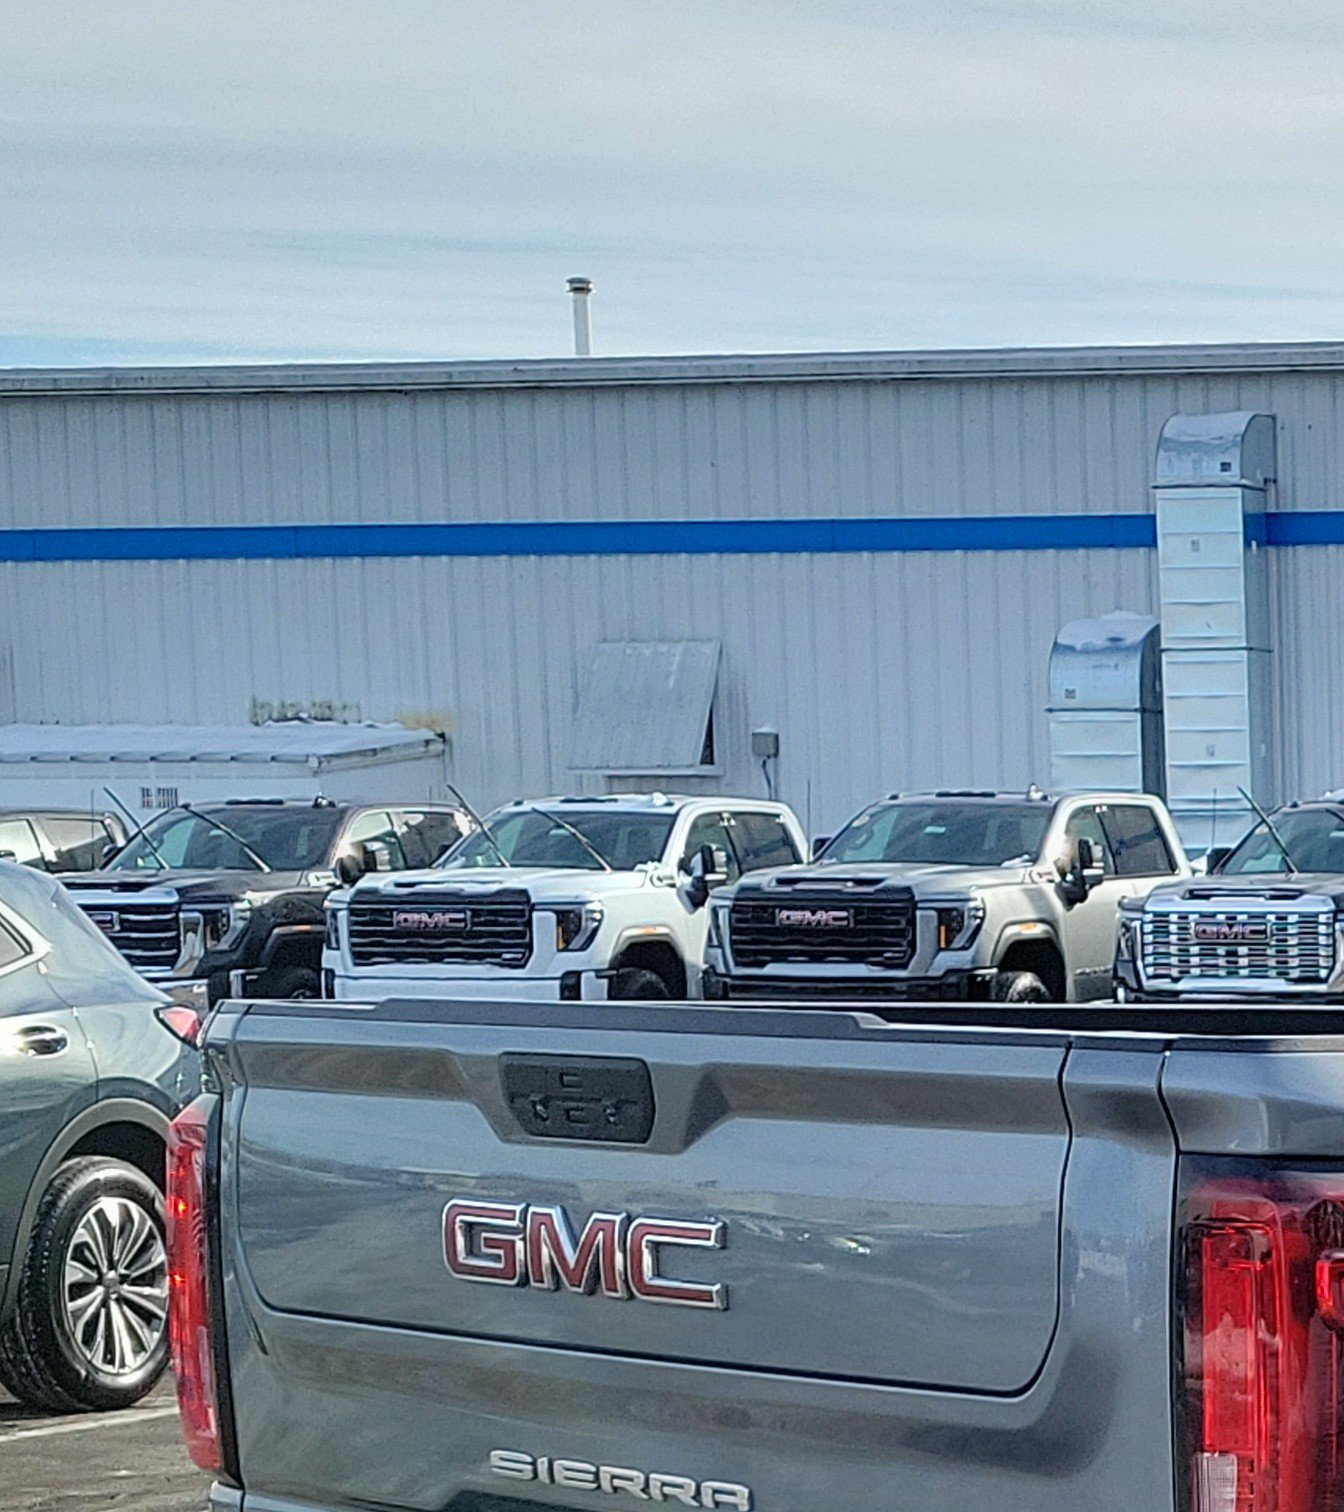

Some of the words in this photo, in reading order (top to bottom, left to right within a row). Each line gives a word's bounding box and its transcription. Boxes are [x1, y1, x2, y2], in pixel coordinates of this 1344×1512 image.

[780, 910, 848, 926] GMC
[442, 1199, 728, 1310] GMC
[489, 1449, 754, 1512] SIERRA
